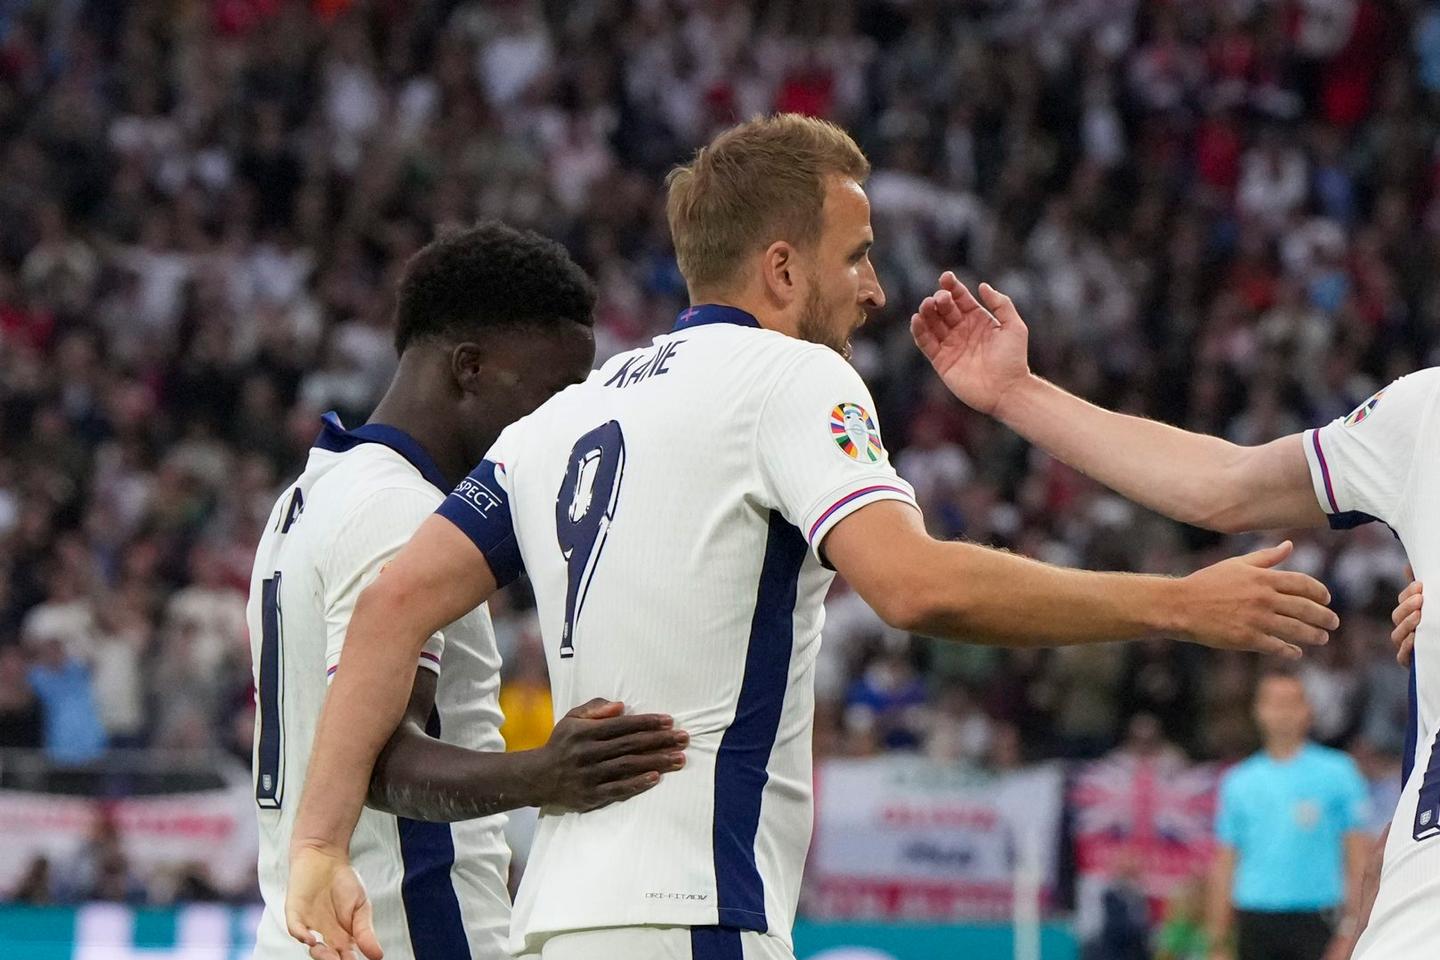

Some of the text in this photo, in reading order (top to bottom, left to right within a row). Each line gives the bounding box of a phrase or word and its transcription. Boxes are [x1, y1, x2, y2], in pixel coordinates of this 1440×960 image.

[603, 339, 688, 389] KANE
[456, 480, 498, 511] SPECT
[556, 419, 625, 658] 9
